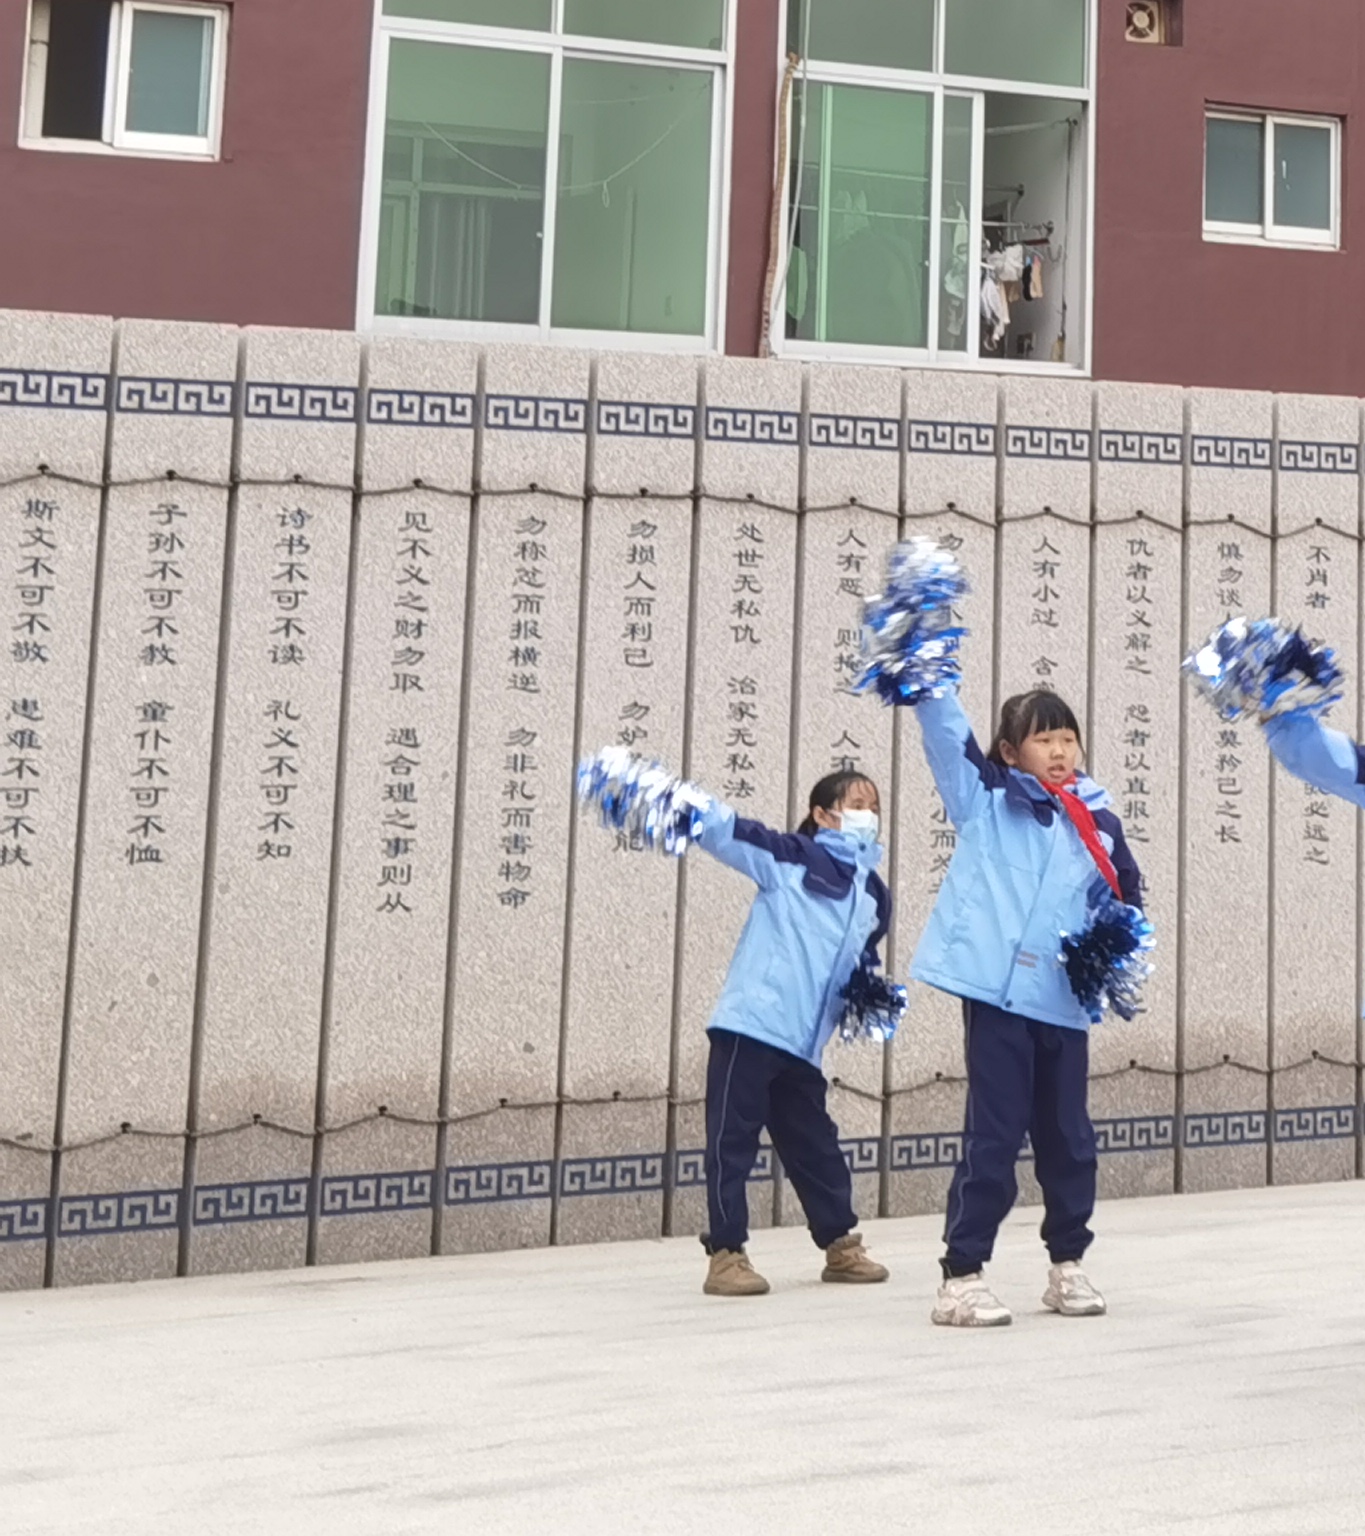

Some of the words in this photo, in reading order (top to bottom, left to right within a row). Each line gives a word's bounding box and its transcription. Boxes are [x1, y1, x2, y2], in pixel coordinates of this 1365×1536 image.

[11, 498, 60, 664] 斯文不可不敬
[141, 504, 188, 666] 子孙不可不教
[267, 507, 313, 666] 诗书不可不读
[389, 511, 433, 694] 见不义之财勿取
[621, 519, 658, 669] 勿损人而利己
[731, 523, 765, 645] 处世无私仇
[1031, 536, 1061, 628] 人有小过
[1123, 538, 1153, 675] 仇者以义解之
[1216, 542, 1245, 619] 慎勿谈
[1305, 545, 1332, 610] 不肖者
[0, 698, 44, 866] 患难不可不扶
[125, 700, 174, 865] 童仆不可不恤
[257, 700, 300, 861] 礼义不可不知
[722, 675, 759, 799] 治家无私法
[830, 730, 861, 772] 人有
[1122, 704, 1151, 843] 怨者以直报之
[377, 727, 422, 914] 遇合理之事则从
[497, 727, 538, 911] 勿非礼而害物命
